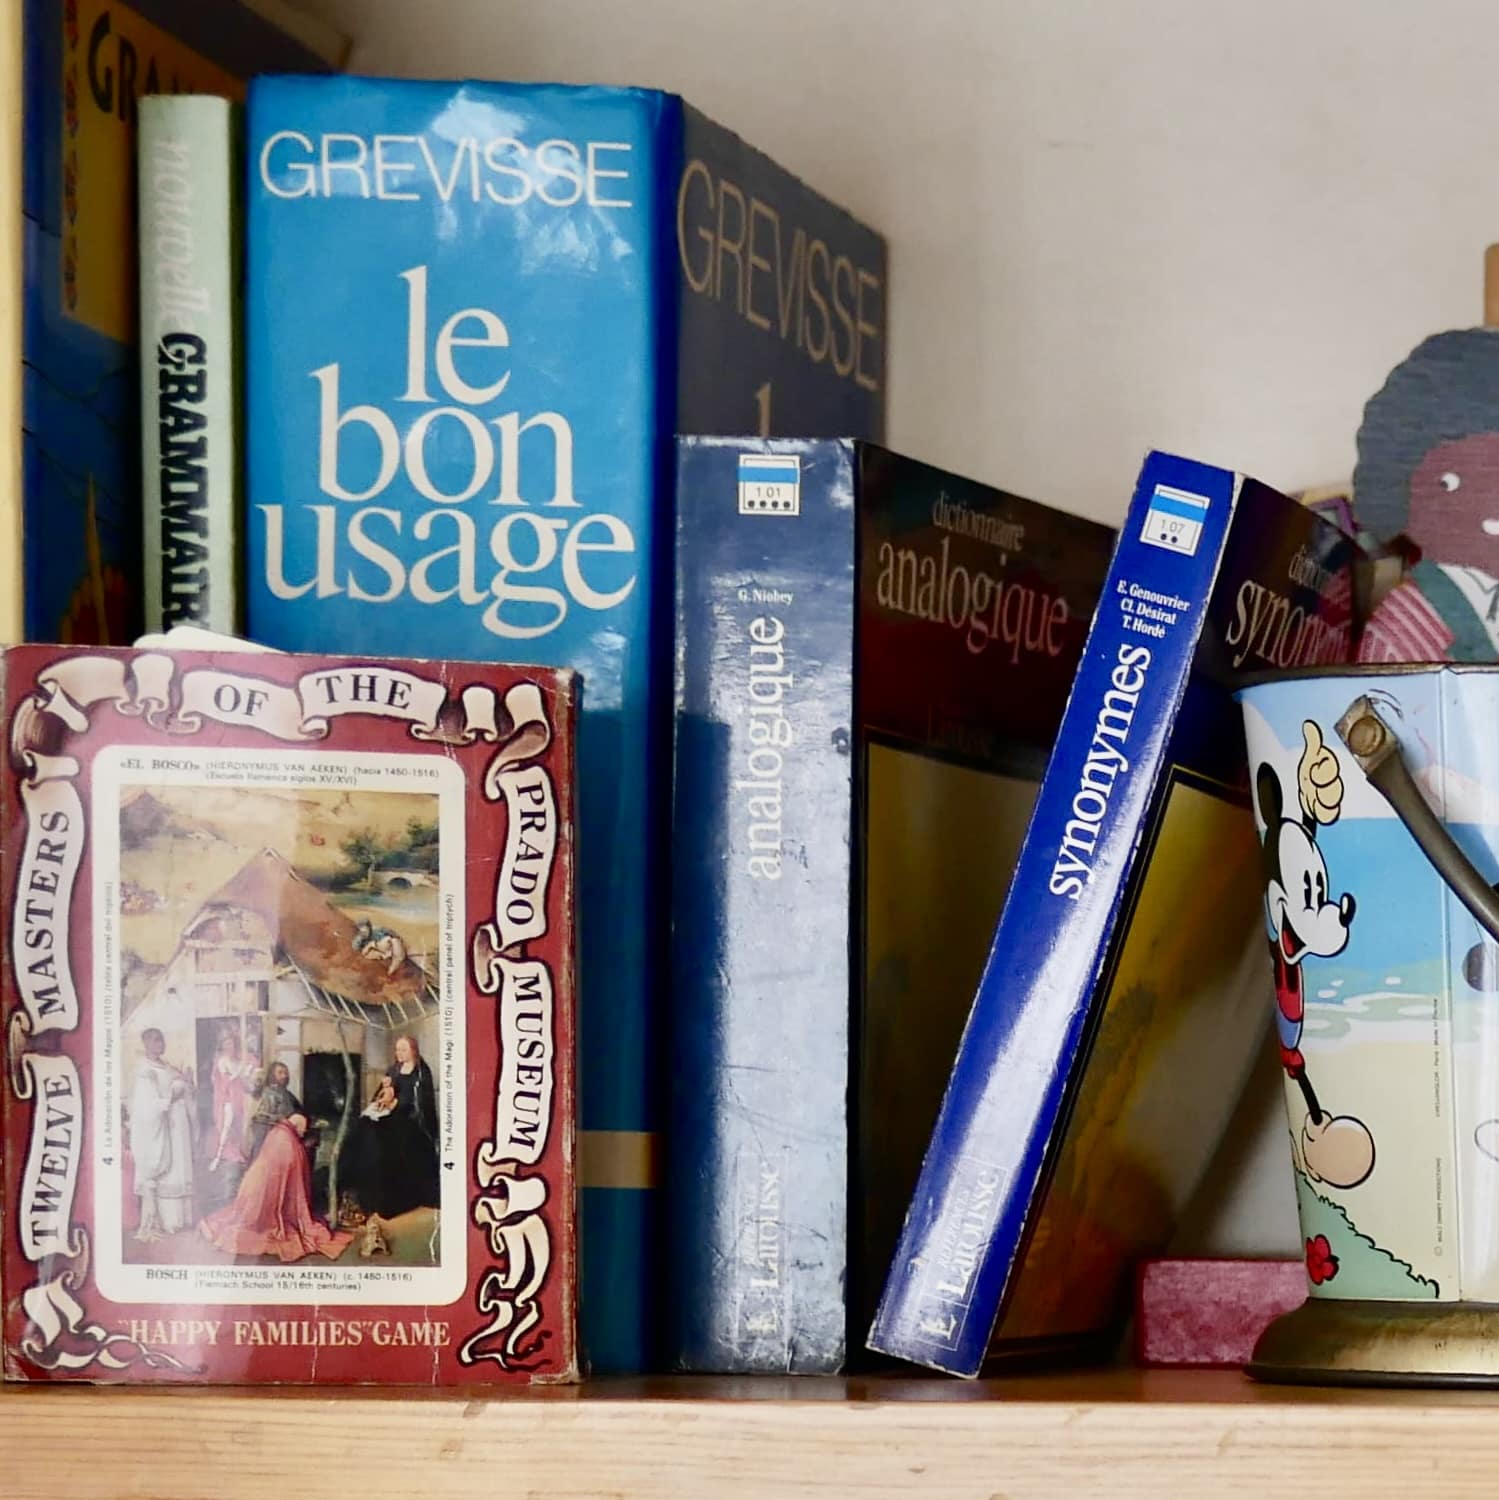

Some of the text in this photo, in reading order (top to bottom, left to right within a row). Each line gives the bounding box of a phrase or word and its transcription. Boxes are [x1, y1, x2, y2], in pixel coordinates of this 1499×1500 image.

[260, 131, 633, 208] GREVISSE
[397, 265, 511, 405] le
[677, 158, 881, 392] GREVISSE
[158, 332, 210, 635] GRAMMAIR
[309, 363, 585, 508] bon
[255, 502, 637, 640] usage
[932, 488, 1027, 553] dictionnaire
[738, 589, 794, 607] G. Niobey
[877, 538, 1071, 666] analogique
[1116, 579, 1192, 613] E. Genouvrier
[1121, 614, 1132, 630] T.
[1136, 602, 1178, 626] Désirat
[212, 671, 413, 718] OF THE
[746, 614, 785, 883] analogique
[1047, 643, 1152, 901] synonymes
[31, 808, 74, 1248] TWELVE MASTERS
[503, 779, 549, 1151] PRADO MUSEUM
[372, 1320, 450, 1347] GAME
